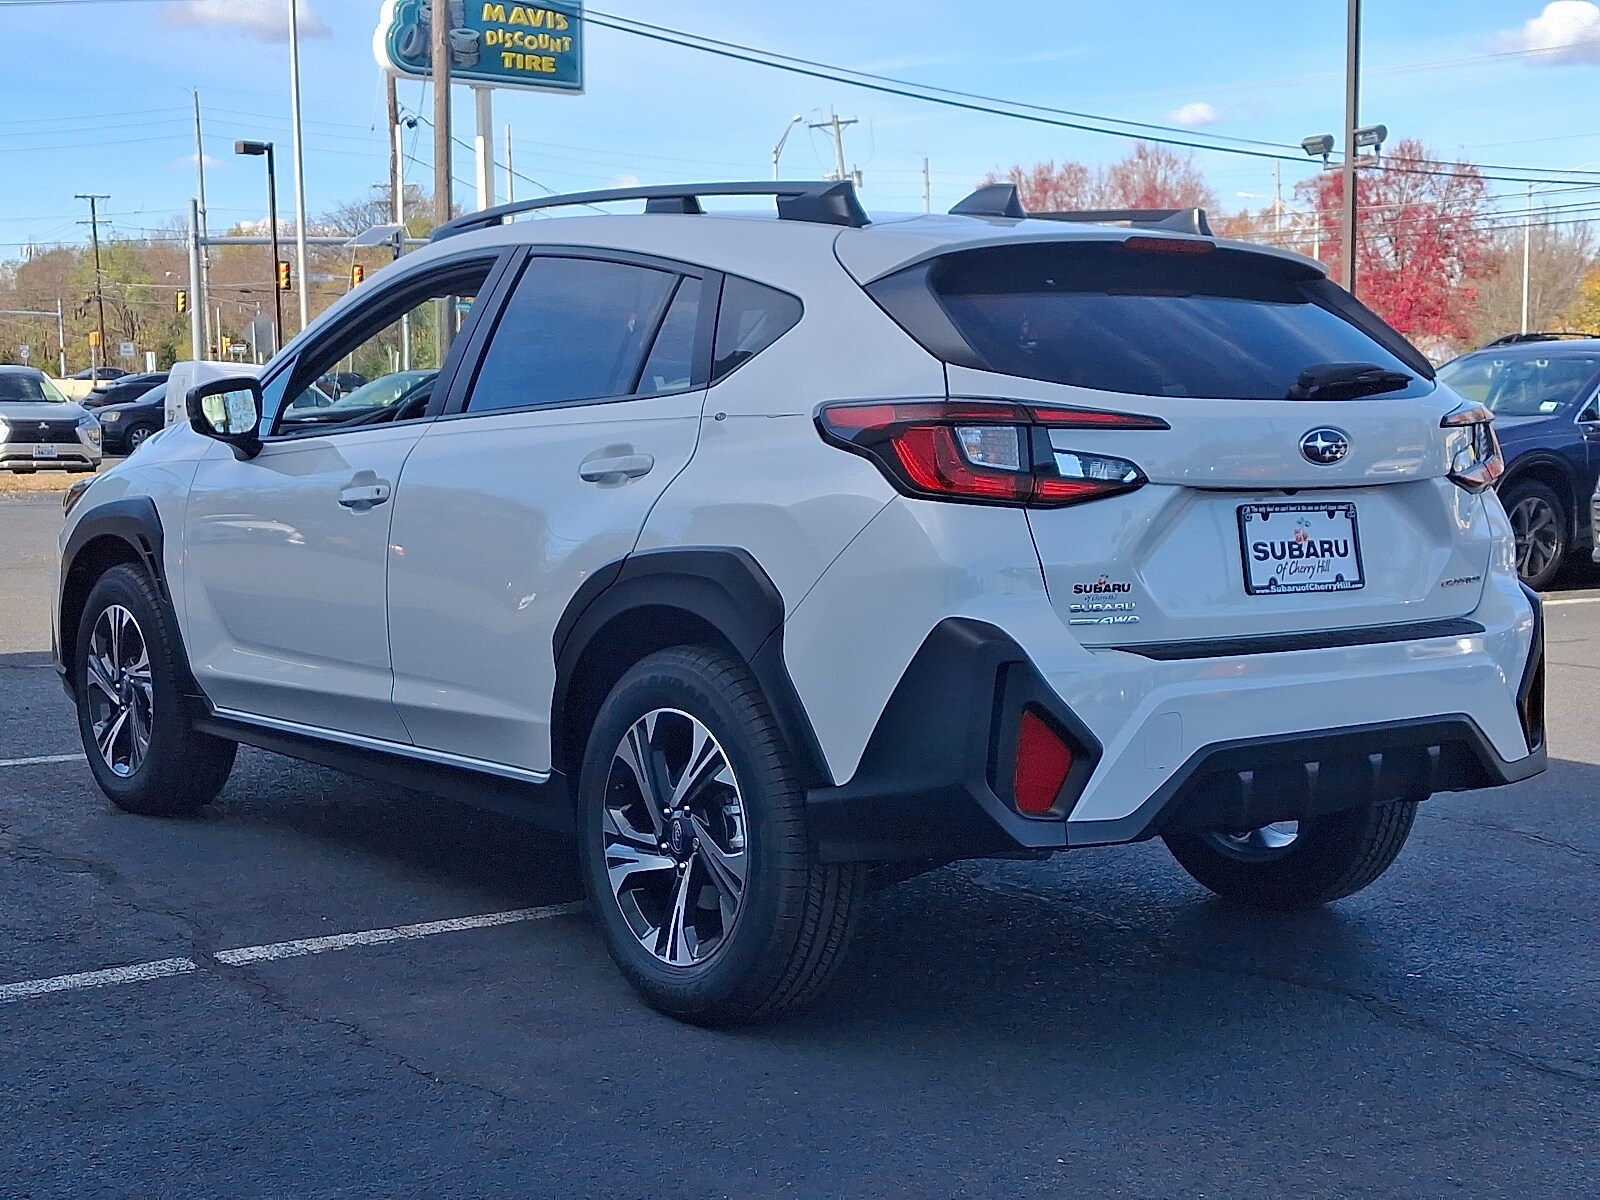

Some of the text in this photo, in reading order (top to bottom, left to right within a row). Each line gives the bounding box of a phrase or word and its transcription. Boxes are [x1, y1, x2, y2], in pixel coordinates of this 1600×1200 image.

[482, 3, 569, 30] MAVIS
[485, 29, 573, 53] DISCOUNT
[501, 51, 557, 73] TIRE
[1252, 539, 1349, 561] SUBARU
[1289, 560, 1316, 579] Cherry
[1316, 559, 1331, 574] Hill
[1073, 583, 1131, 594] SUBARU
[1069, 602, 1136, 613] SUBARU
